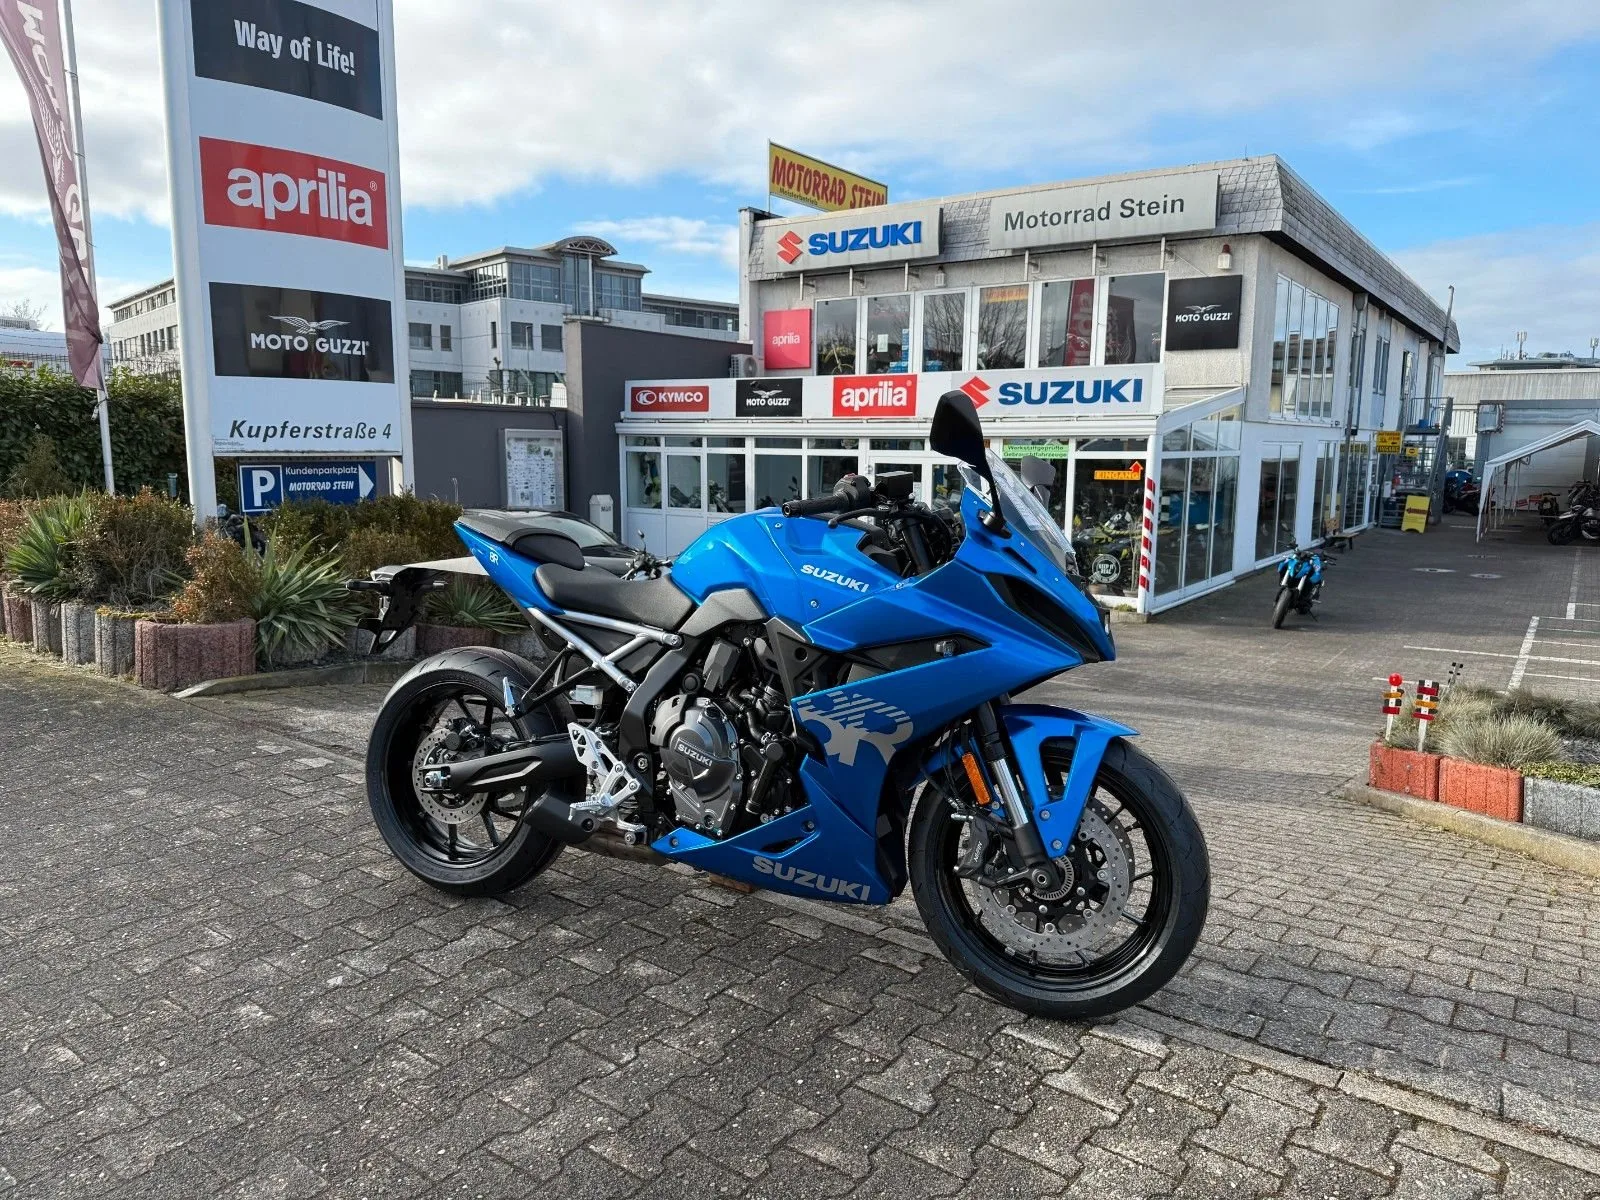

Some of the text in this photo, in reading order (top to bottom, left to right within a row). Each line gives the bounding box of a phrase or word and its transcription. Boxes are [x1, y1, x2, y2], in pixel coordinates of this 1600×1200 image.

[234, 19, 356, 76] Way of Life!
[771, 155, 847, 206] MOTORRAD
[227, 166, 374, 227] aprilia
[1004, 193, 1186, 232] Motorrad Stein
[808, 220, 922, 256] SUZUKI
[1175, 311, 1231, 323] MOTO GUZZI
[251, 333, 367, 356] MOTO GUZZI
[772, 331, 801, 346] aprilia
[658, 391, 704, 403] KYMCO
[746, 398, 790, 407] MOTO GUZZI
[841, 380, 908, 409] aprilia
[998, 379, 1143, 405] SUZUKI
[229, 419, 392, 442] Kupferstraße 4
[285, 465, 358, 476] Kundenparkplatz
[1095, 471, 1139, 479] EINGANG
[252, 469, 275, 507] P
[289, 480, 355, 492] MOTORRAD STEIN
[800, 564, 870, 593] SUZUKI
[677, 743, 713, 767] SUZUKI
[752, 856, 871, 902] SUZUKI
